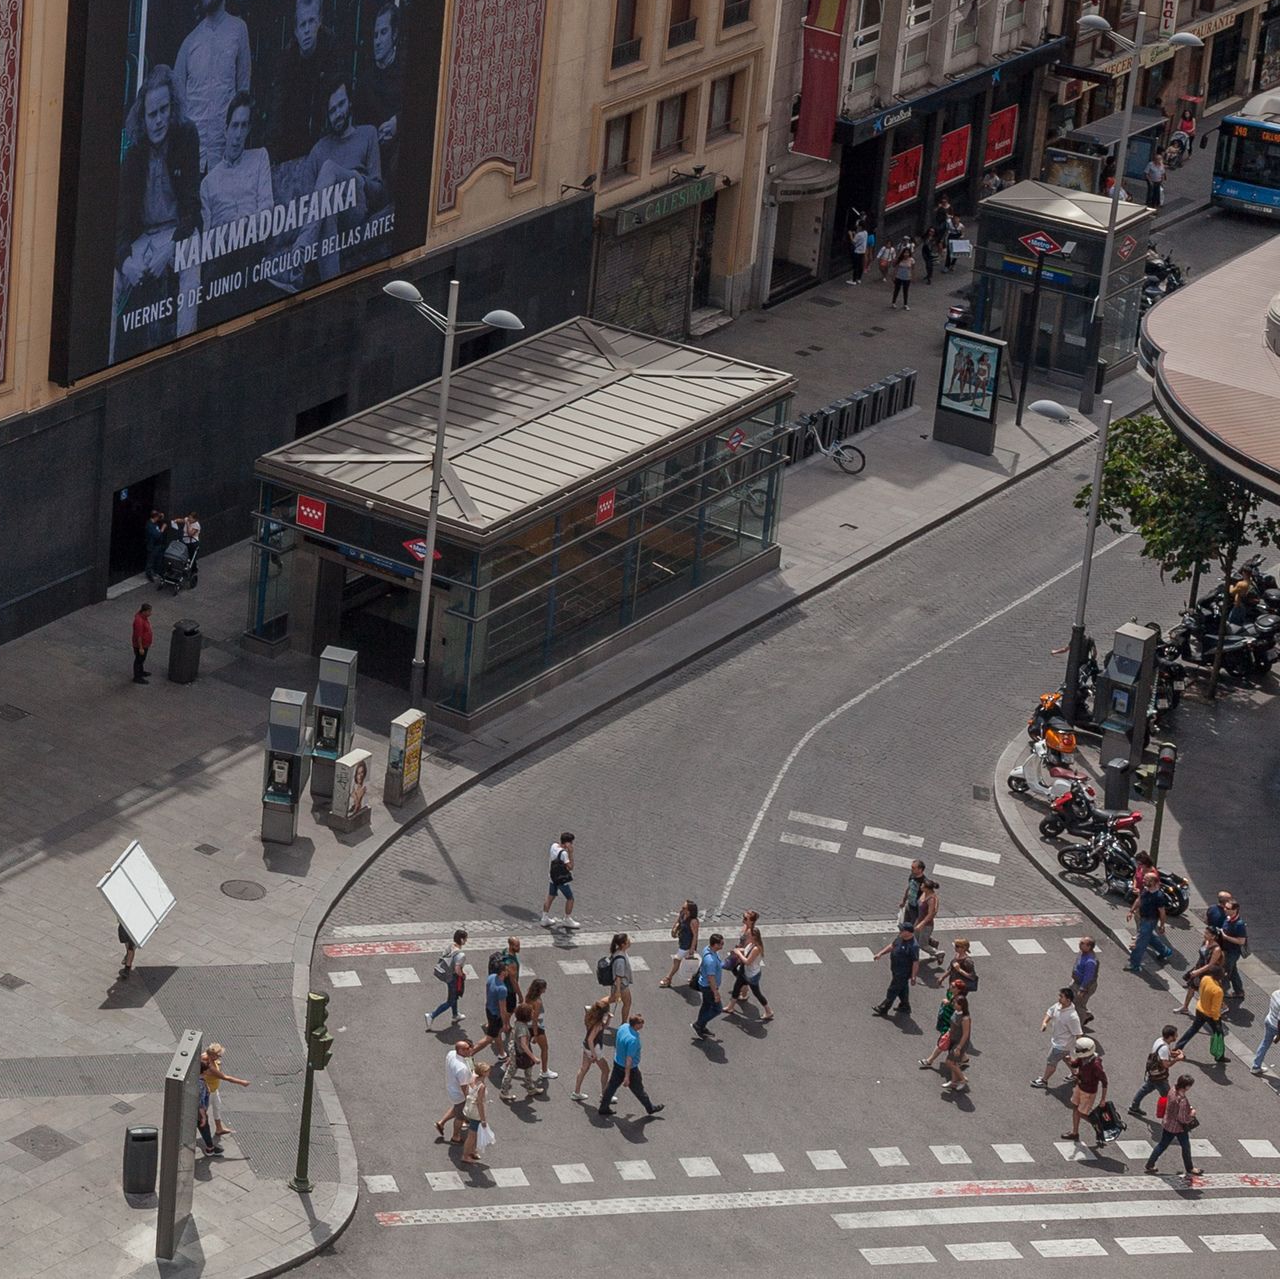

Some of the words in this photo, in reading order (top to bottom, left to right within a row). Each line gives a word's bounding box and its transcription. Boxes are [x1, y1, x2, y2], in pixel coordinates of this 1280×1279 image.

[173, 177, 358, 273] KAKKMADDAFAKKA
[1030, 239, 1050, 249] Metro
[122, 298, 173, 333] VIERNES
[176, 293, 184, 313] 9
[188, 283, 203, 308] DE
[206, 271, 242, 301] JUNIO
[252, 249, 301, 284] CÍRCULO
[304, 243, 319, 265] DE
[321, 228, 361, 256] BELLAS
